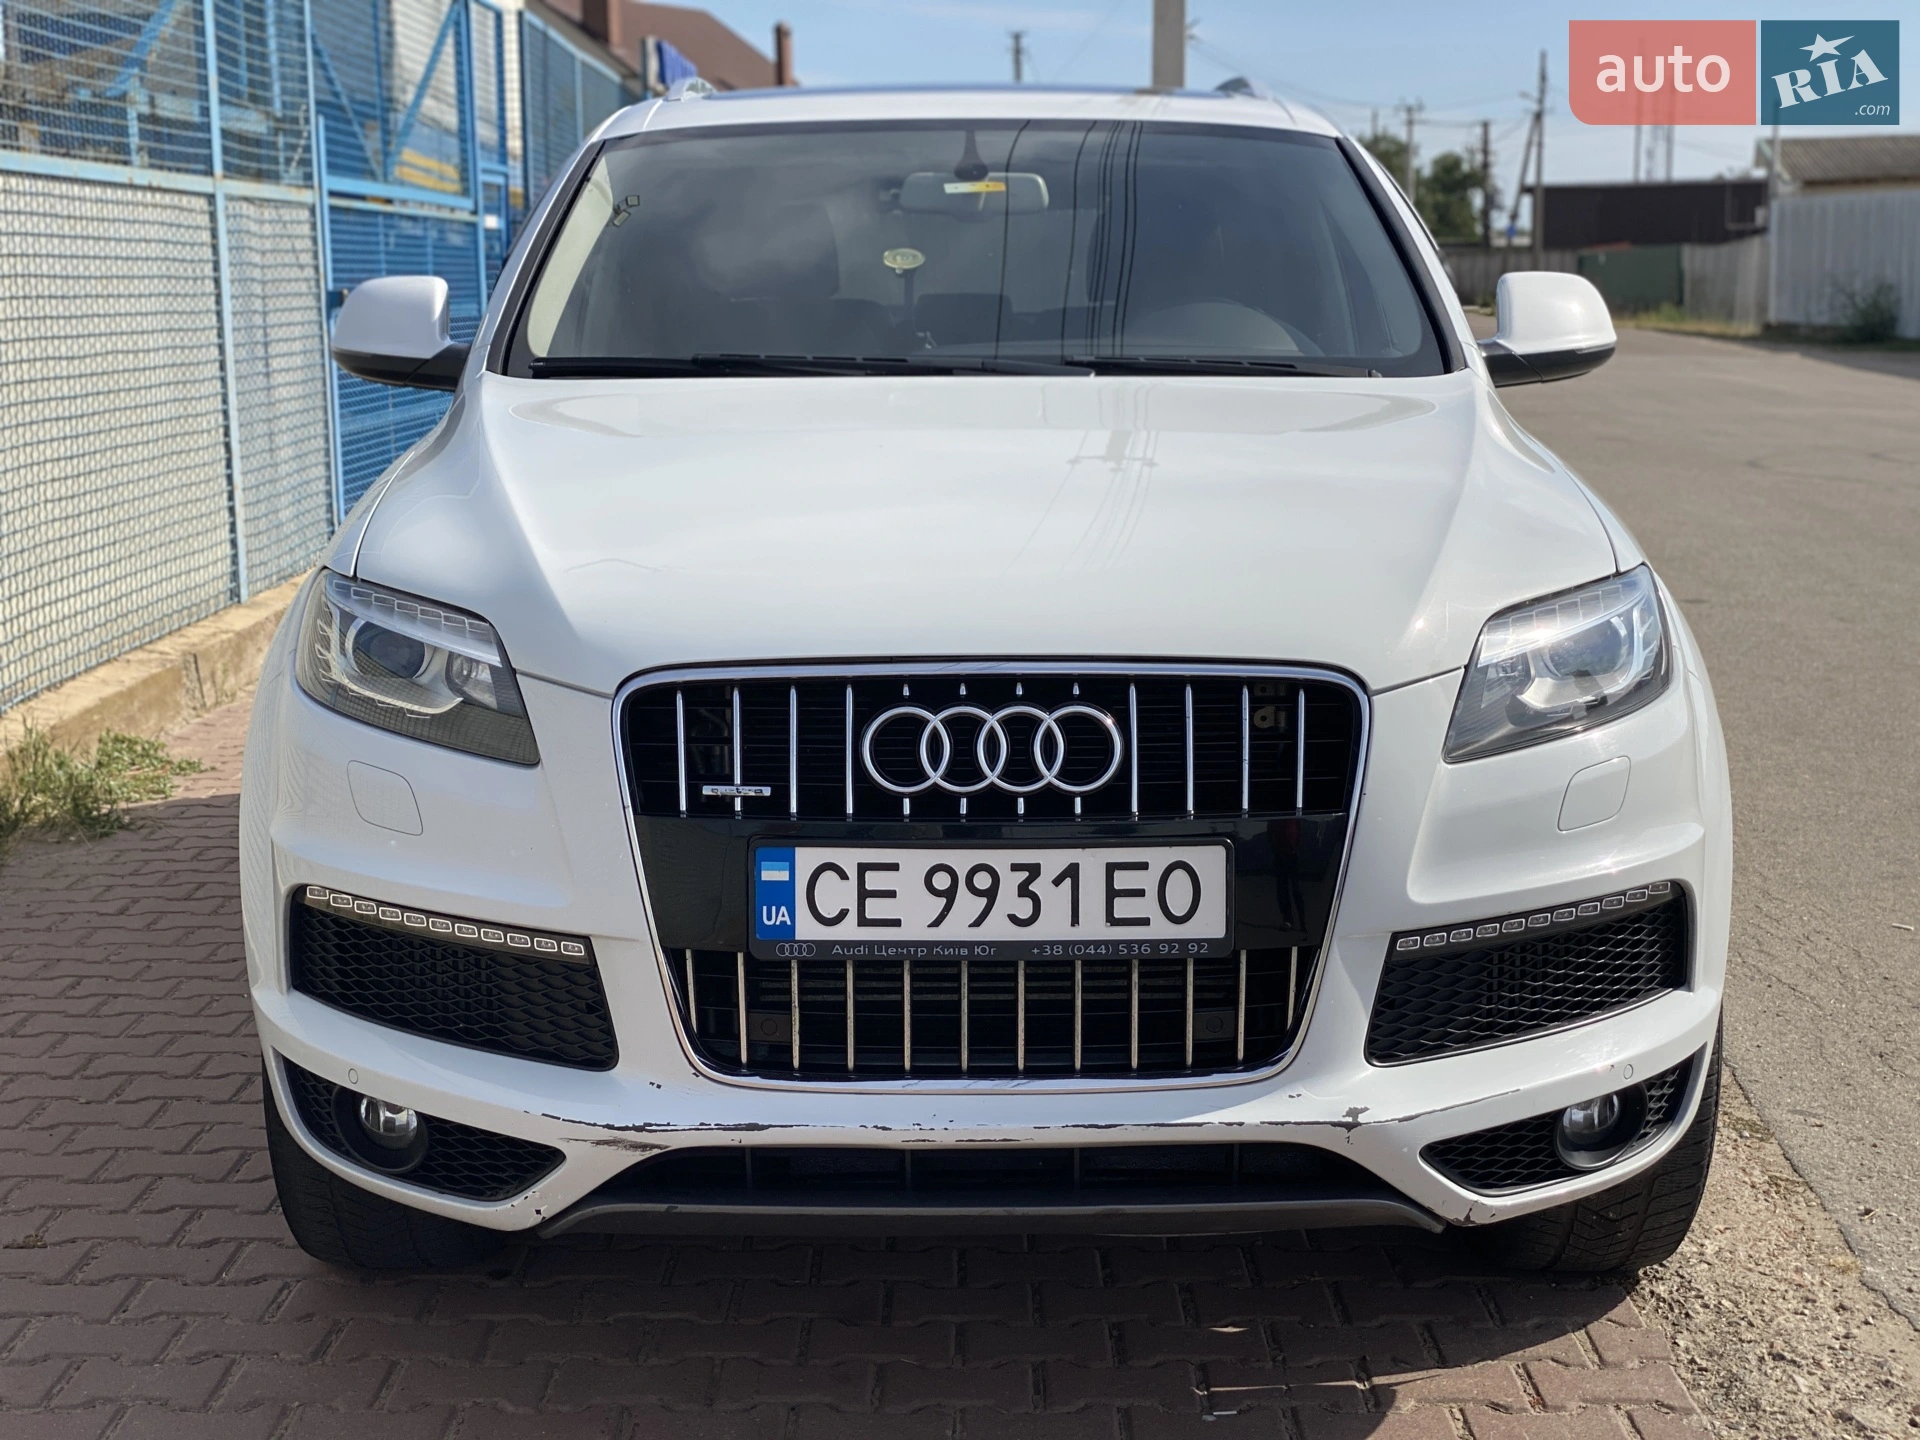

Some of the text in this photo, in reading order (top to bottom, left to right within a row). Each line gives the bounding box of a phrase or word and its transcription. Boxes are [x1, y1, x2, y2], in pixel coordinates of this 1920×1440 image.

[805, 859, 1201, 928] CE 9931 EO
[761, 906, 792, 926] UA
[831, 944, 996, 957] Audi Центр Київ Юг
[1031, 942, 1209, 956] +38 (044) 536 92 92
